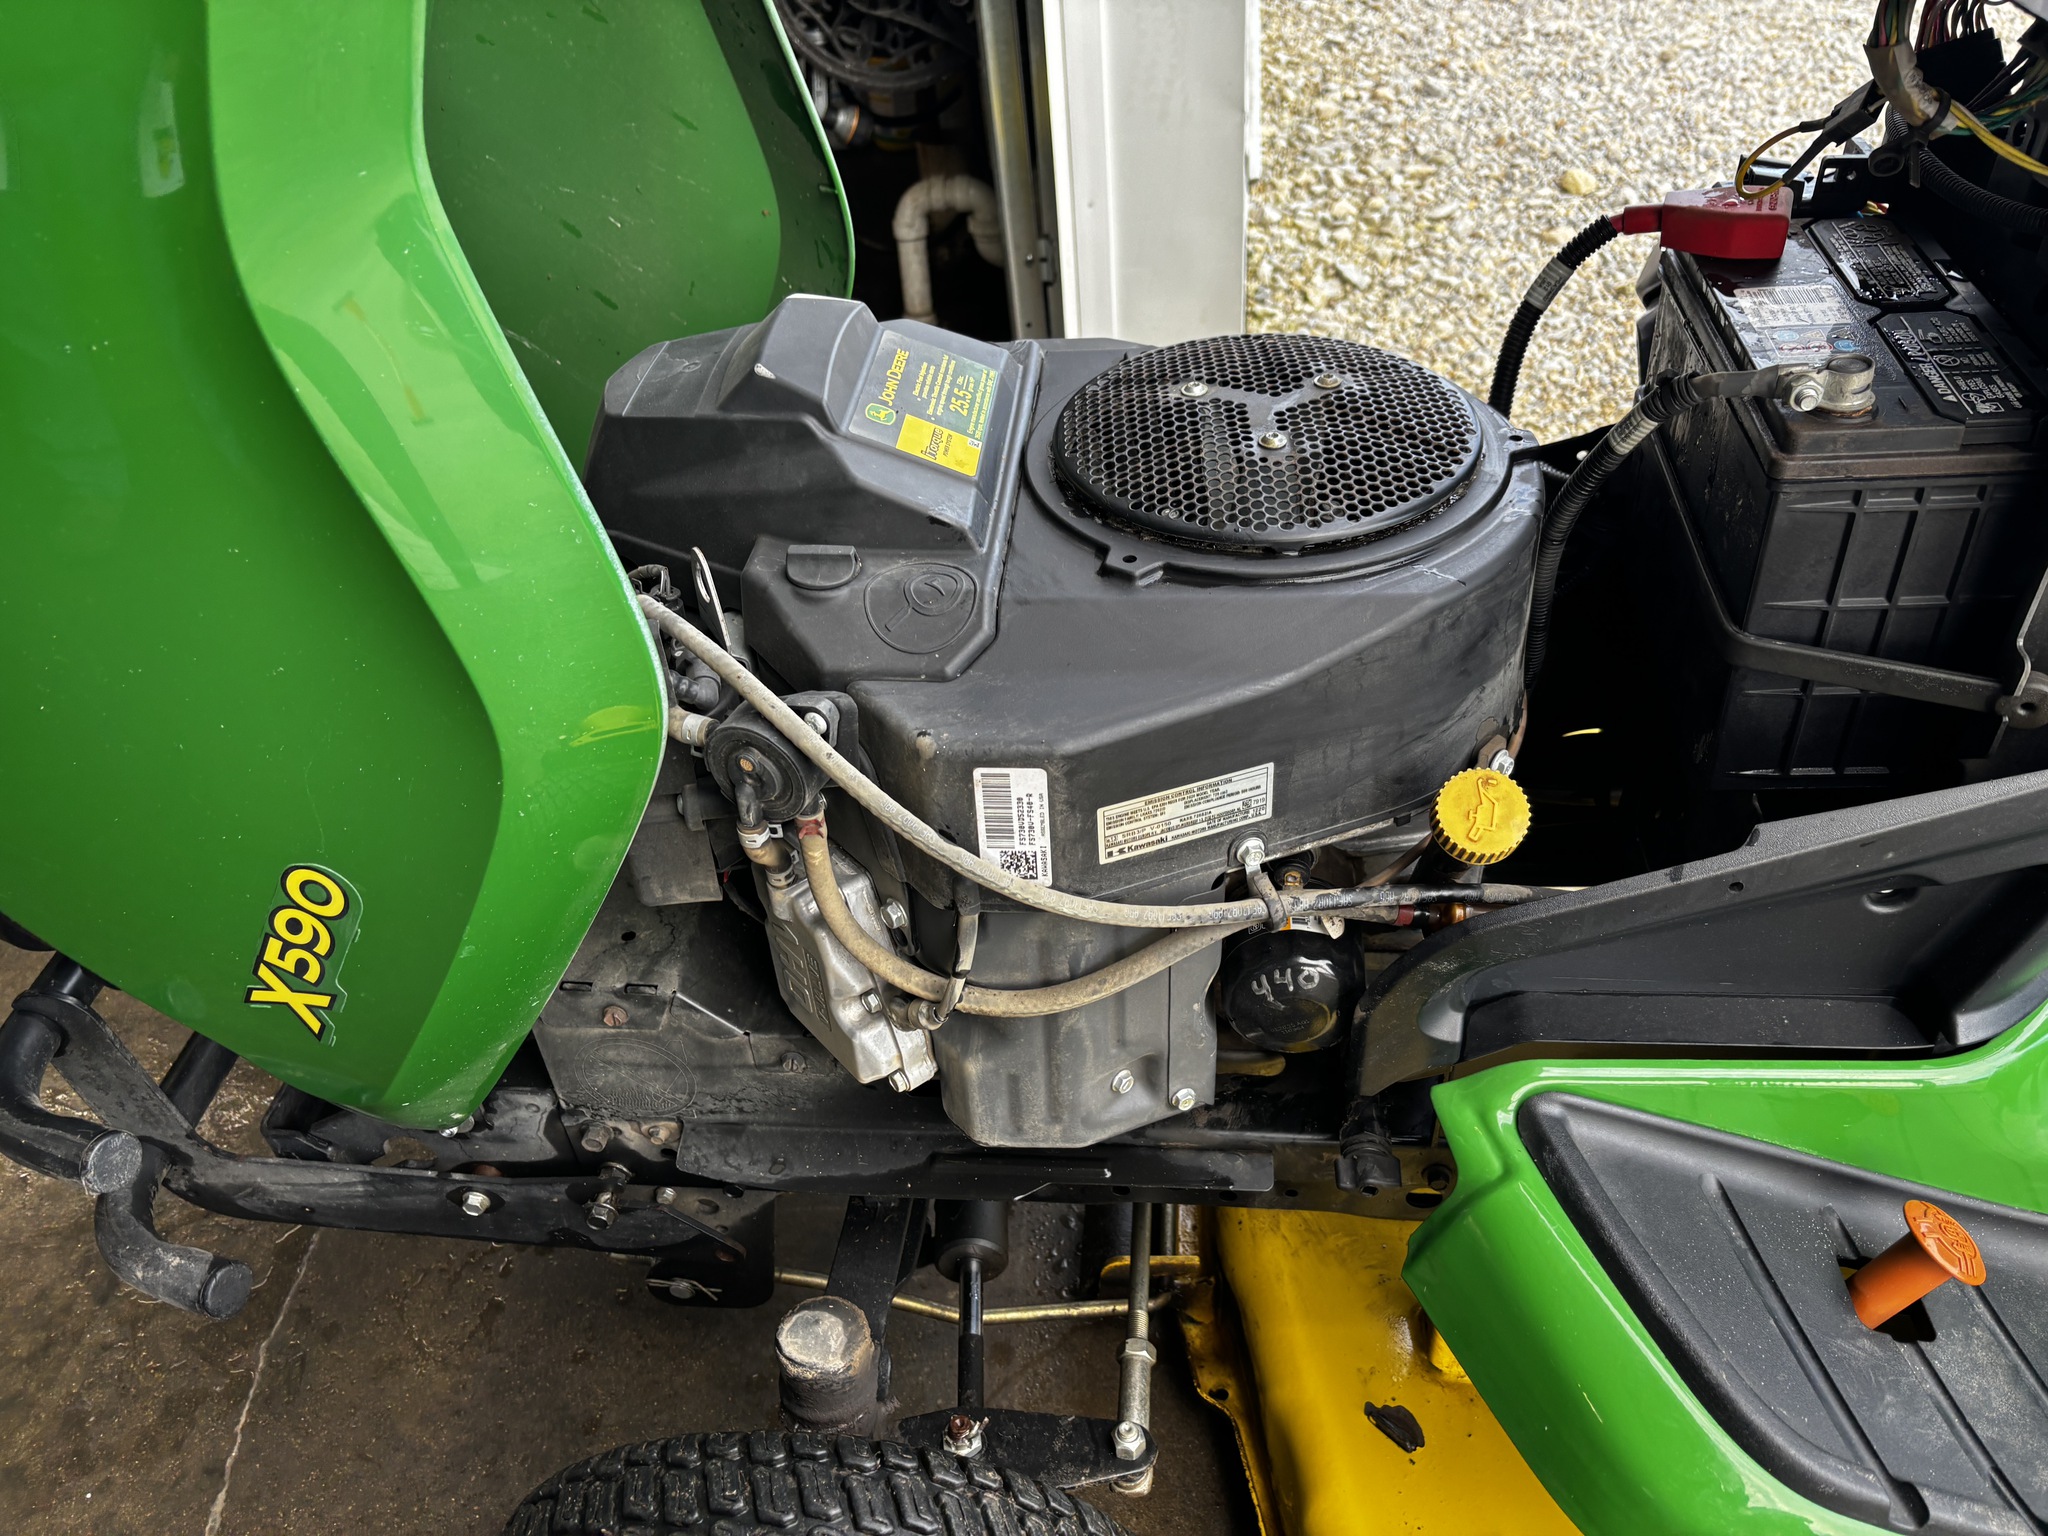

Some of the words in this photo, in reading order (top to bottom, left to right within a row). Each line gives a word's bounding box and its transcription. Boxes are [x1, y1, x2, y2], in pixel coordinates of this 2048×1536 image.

[887, 349, 908, 378] DEERE
[1919, 363, 1950, 393] DANGER
[880, 379, 898, 405] JOHN
[950, 388, 971, 415] 25.5
[1144, 795, 1169, 805] EMISSION
[1171, 788, 1195, 798] CONTROL
[1197, 778, 1232, 791] INFORMATION
[1150, 821, 1171, 830] V-0150
[1127, 835, 1167, 851] Kawasaki
[246, 866, 348, 1040] X590
[1251, 967, 1320, 1010] 440
